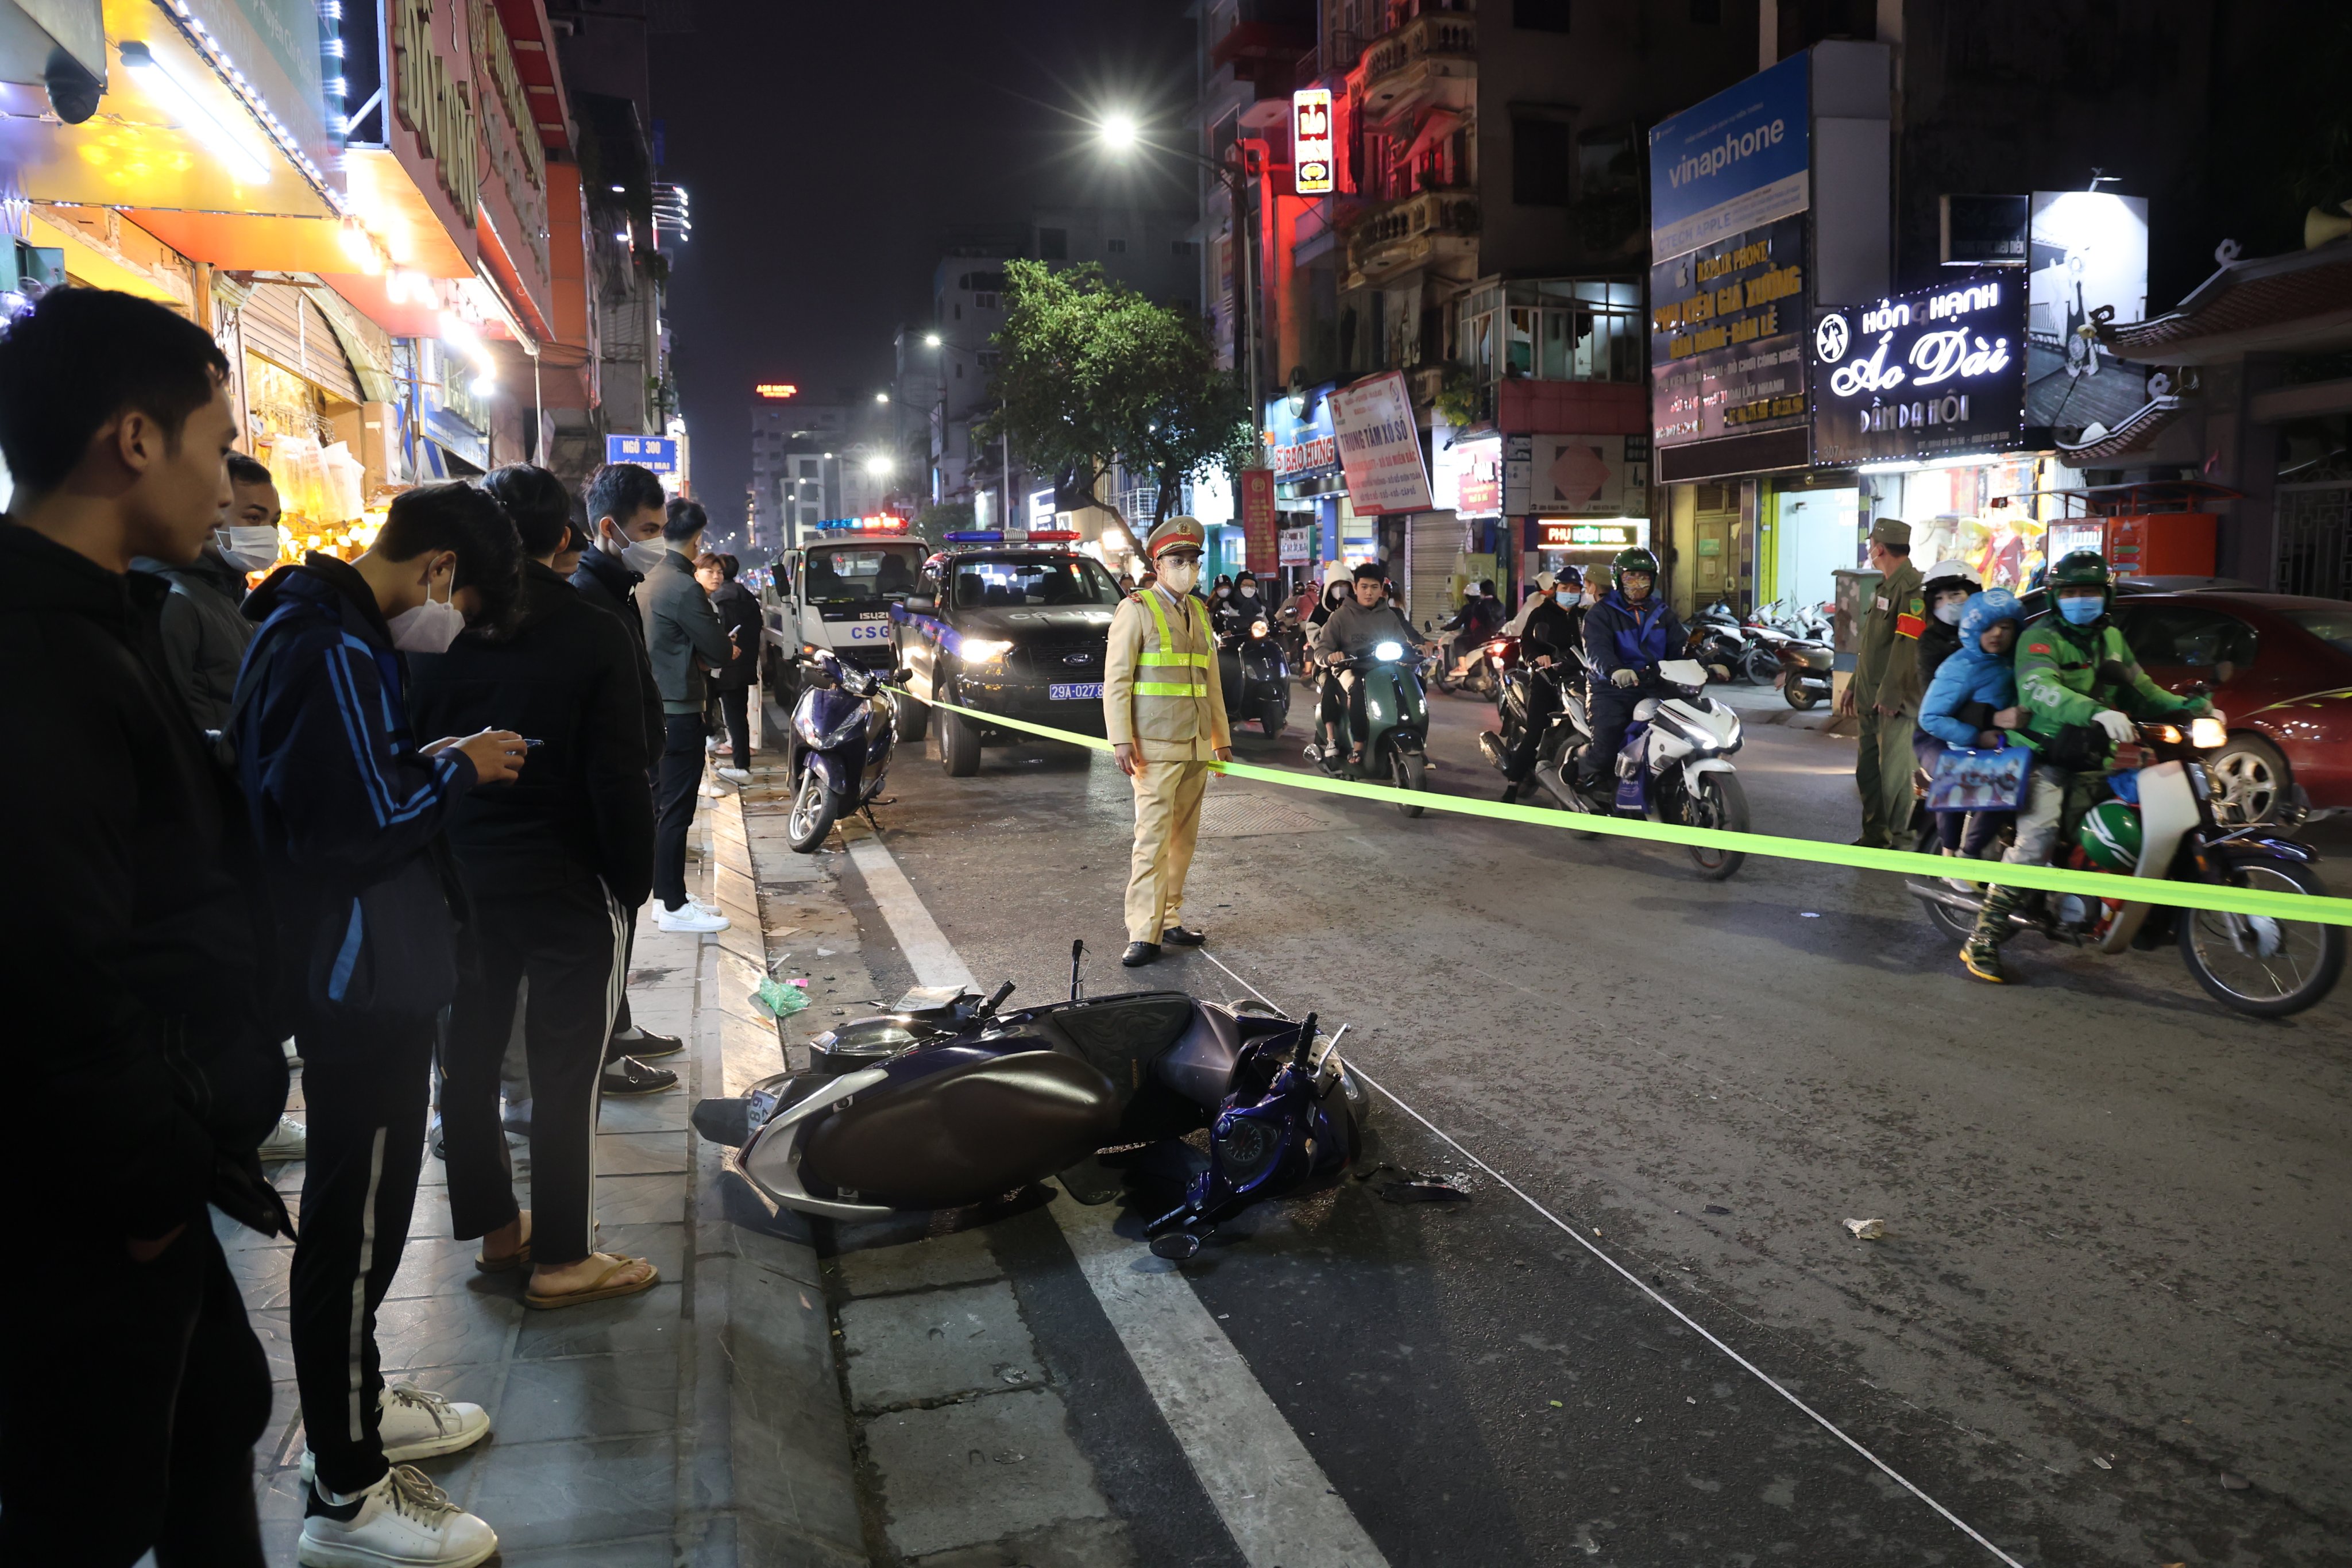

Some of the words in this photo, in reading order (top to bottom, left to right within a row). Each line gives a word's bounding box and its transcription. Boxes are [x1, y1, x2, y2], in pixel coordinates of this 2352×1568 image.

[1669, 118, 1784, 188] vinaphone
[1696, 213, 1731, 237] APPLE
[1697, 253, 1732, 283] REPAIR
[1733, 240, 1768, 271] PHONE
[1929, 283, 1998, 323] HẠNH
[1830, 331, 1906, 396] Áo
[1909, 326, 2010, 386] Dài
[622, 438, 640, 454] NGÕ
[645, 441, 661, 454] 300
[1340, 430, 1365, 453] TRUNG
[1364, 423, 1383, 448] TÂM
[1381, 414, 1395, 445] XỔ
[1395, 411, 1408, 442] SỐ
[654, 461, 670, 470] MAI
[1285, 435, 1304, 473] BẢO
[1548, 527, 1571, 545] PHỤ
[1573, 526, 1599, 545] KIỆN
